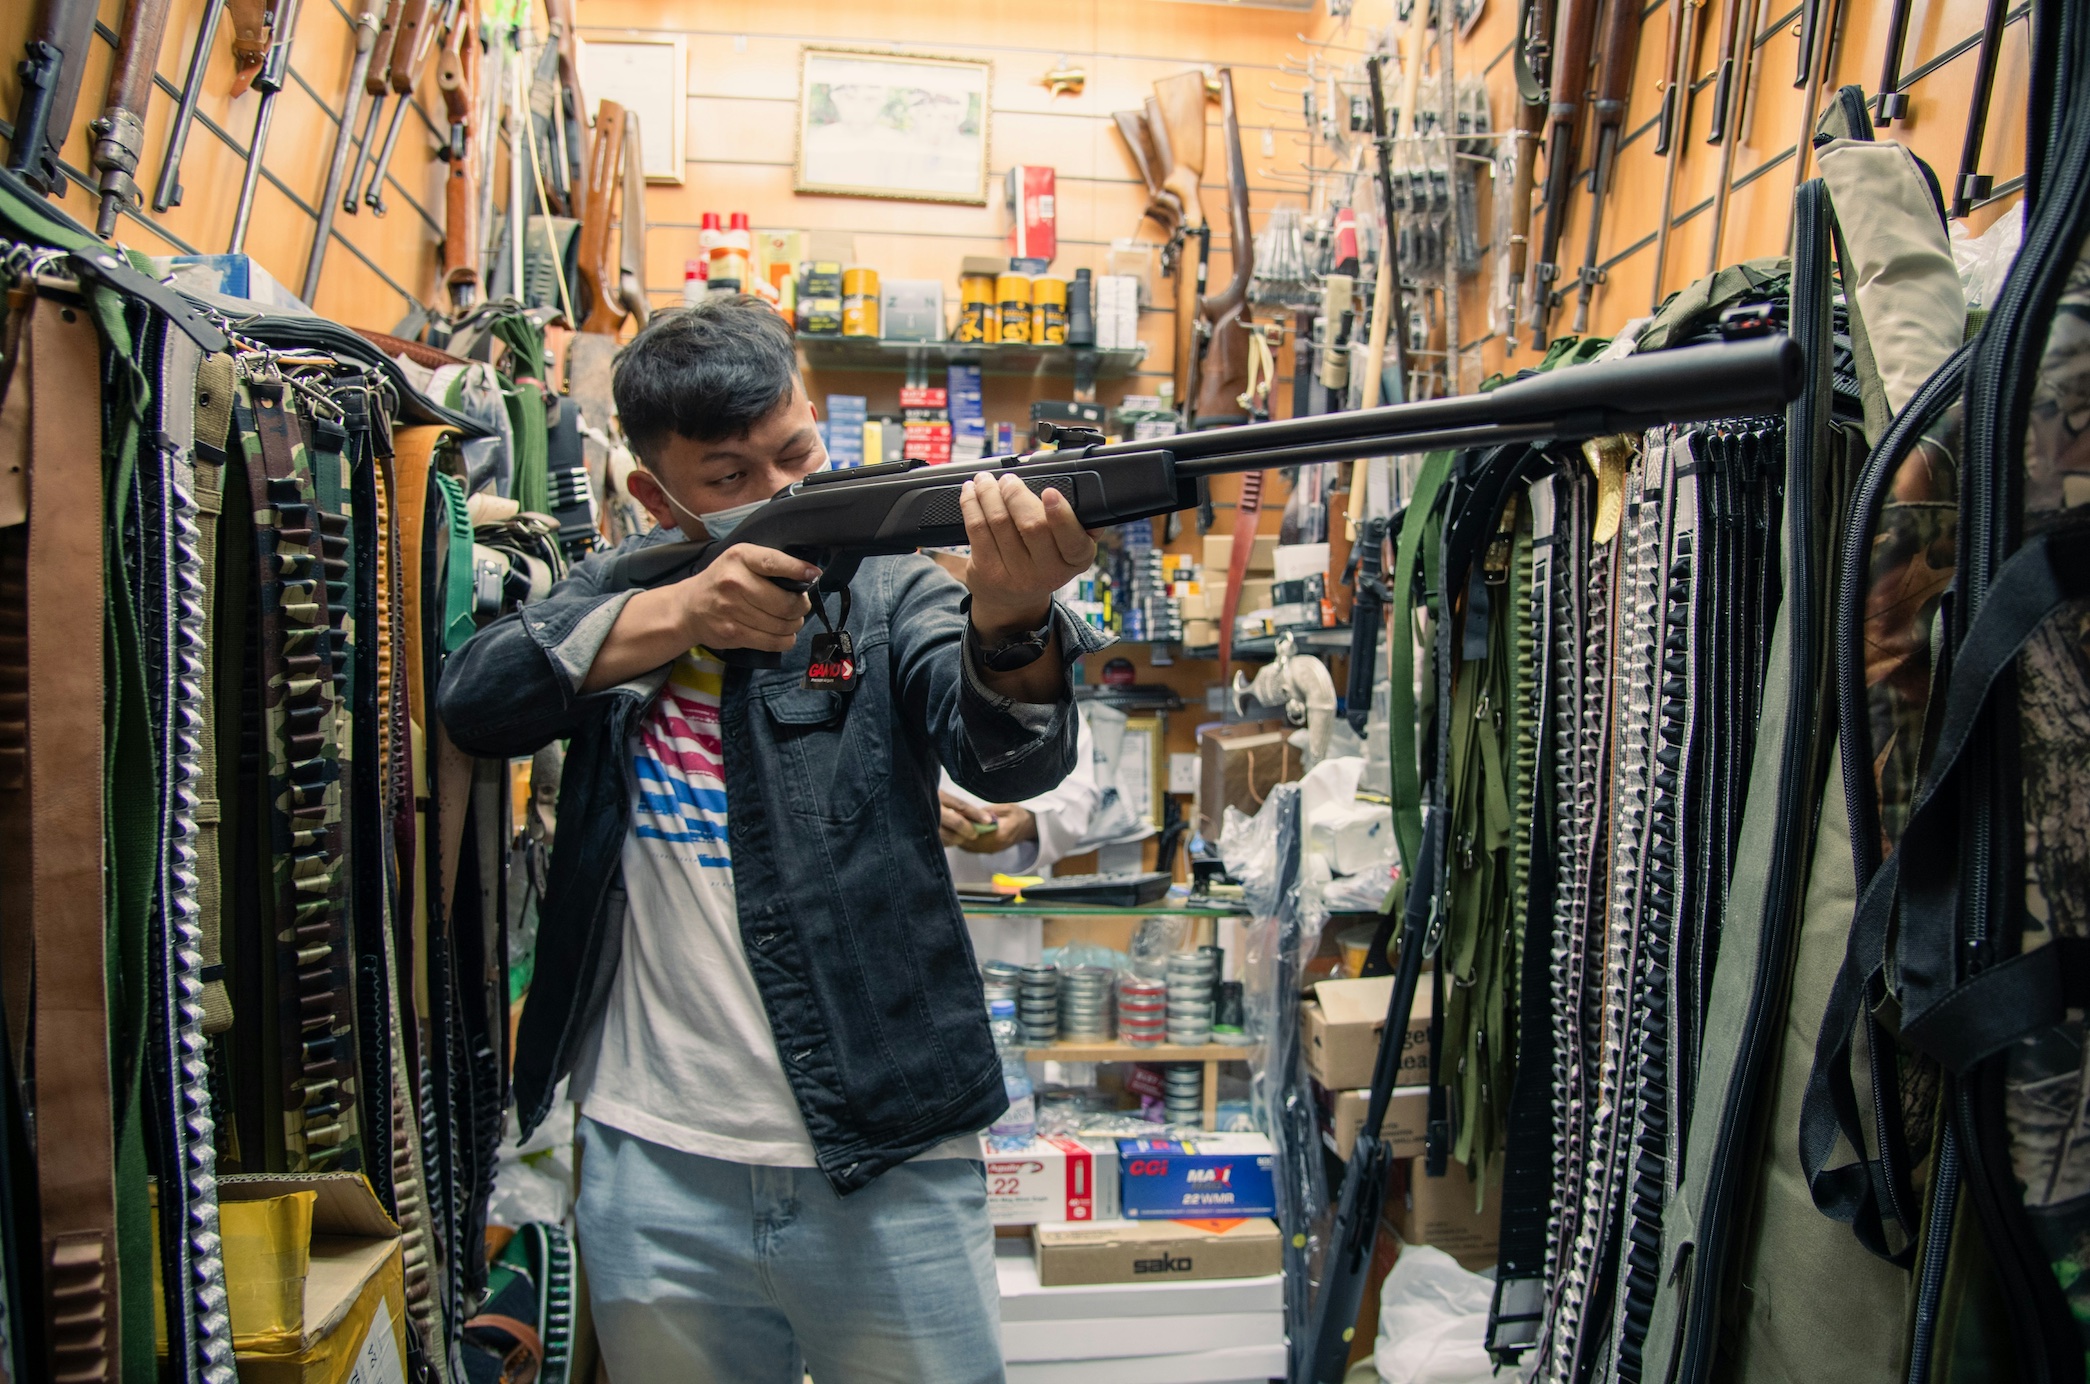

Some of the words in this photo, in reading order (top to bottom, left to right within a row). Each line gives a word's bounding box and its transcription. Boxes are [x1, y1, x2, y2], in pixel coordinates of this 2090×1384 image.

[808, 664, 841, 678] GAMO
[1187, 1165, 1232, 1185] MAXI
[1133, 1251, 1193, 1274] sako
